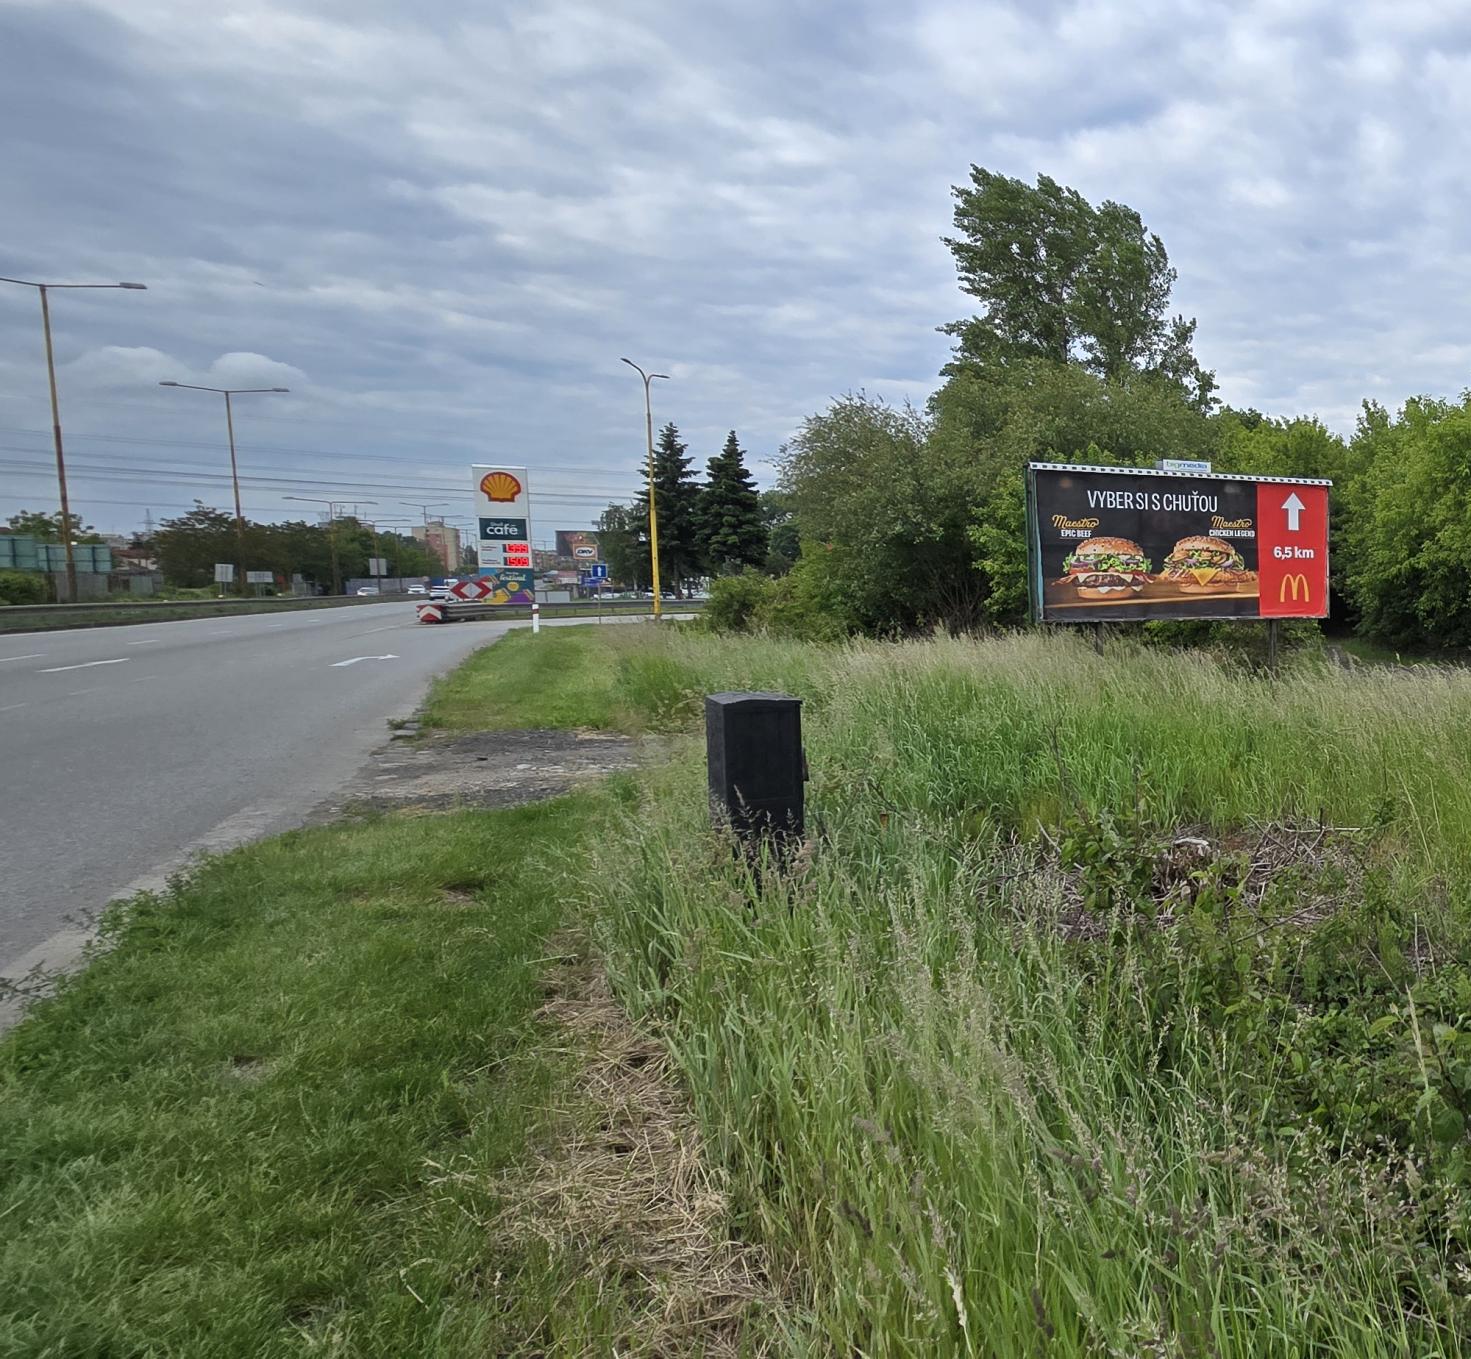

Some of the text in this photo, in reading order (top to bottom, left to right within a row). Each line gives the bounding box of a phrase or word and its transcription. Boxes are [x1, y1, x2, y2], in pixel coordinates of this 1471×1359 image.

[1087, 490, 1218, 512] VYBER SI S CHUŤOU
[1052, 514, 1099, 529] Maestro
[1211, 515, 1252, 529] Maestro
[1061, 529, 1092, 538] EPIC BEEF
[1209, 529, 1255, 538] CHICKEN LEGEND
[1273, 546, 1314, 560] 6,5 km
